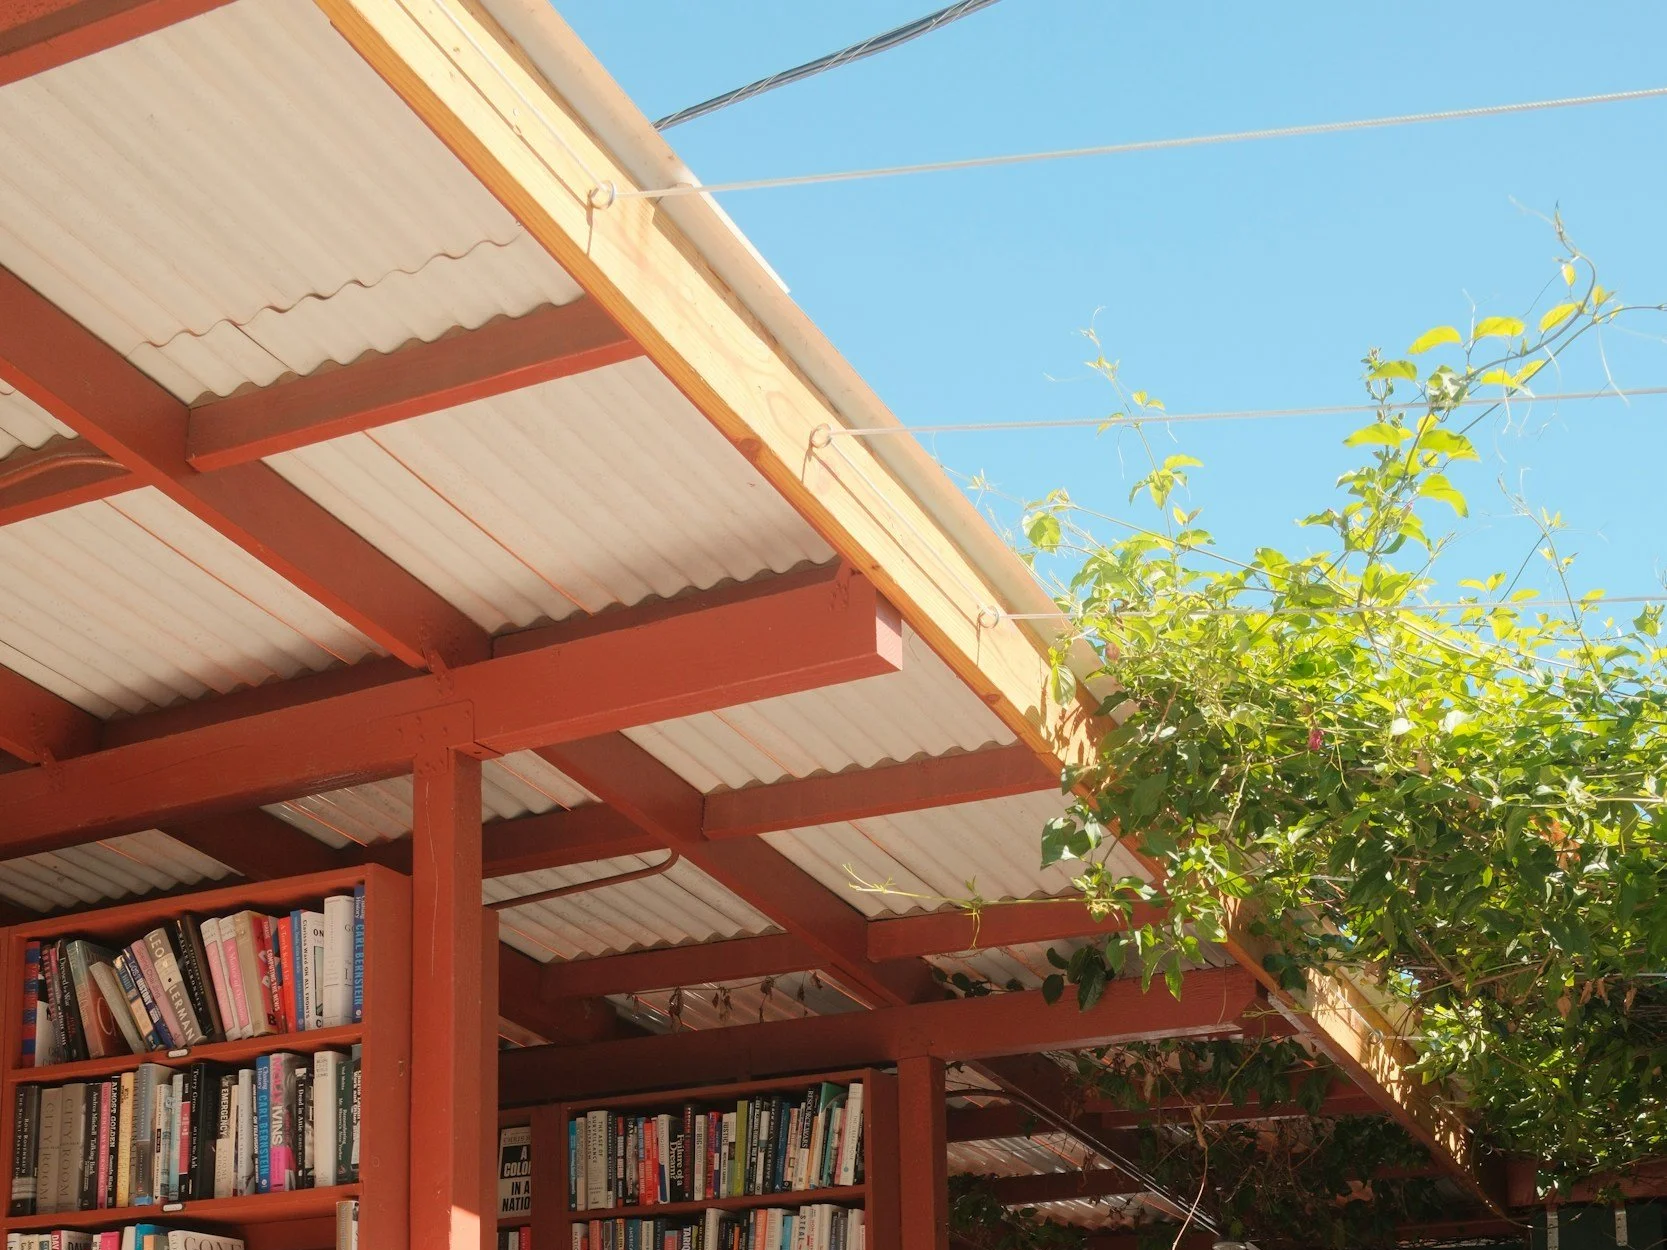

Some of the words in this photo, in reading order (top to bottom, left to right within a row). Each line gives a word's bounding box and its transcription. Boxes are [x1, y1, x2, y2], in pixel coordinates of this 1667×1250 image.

[355, 924, 364, 950] CARL
[59, 957, 69, 985] Dressed
[267, 949, 276, 980] COMPUTING
[354, 953, 364, 1005] BERNSTEIN
[128, 960, 140, 979] LOST
[136, 978, 152, 1006] HISTORY
[148, 933, 166, 957] LEO
[169, 985, 195, 1041] LERMAN
[191, 1069, 199, 1089] Terry
[64, 1098, 74, 1140] CITY
[220, 1088, 229, 1135] EMERGENCY
[259, 1095, 268, 1119] CARL
[44, 1102, 54, 1143] CITY
[272, 1105, 283, 1145] IVINS
[259, 1123, 269, 1174] BERNSTEIN
[676, 1134, 684, 1168] Failure
[801, 1128, 809, 1148] WARS
[520, 1146, 528, 1160] A
[40, 1153, 52, 1200] ROOM
[62, 1149, 71, 1197] ROOM
[503, 1161, 531, 1177] COLO
[677, 1169, 683, 1177] of
[511, 1181, 520, 1196] IN
[523, 1180, 531, 1195] A
[502, 1197, 531, 1212] NATIO
[681, 1226, 692, 1250] TARIQ
[798, 1215, 806, 1242] STEAL
